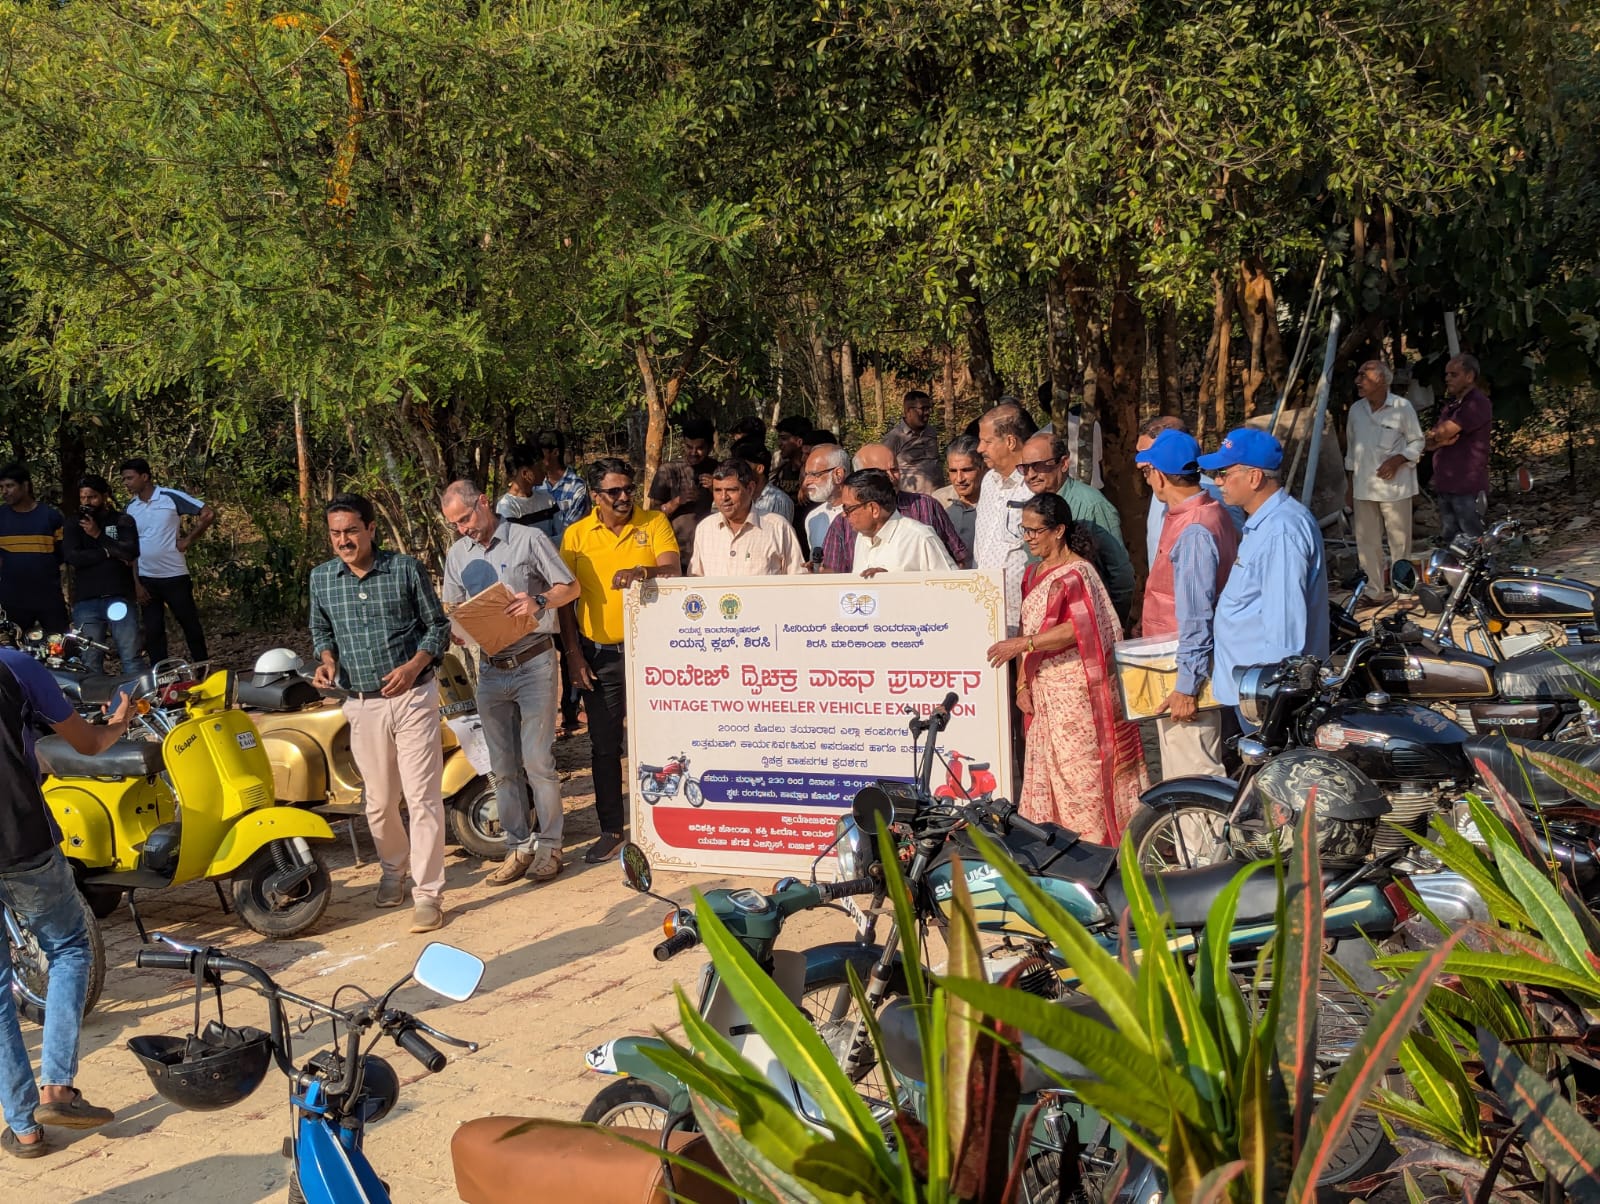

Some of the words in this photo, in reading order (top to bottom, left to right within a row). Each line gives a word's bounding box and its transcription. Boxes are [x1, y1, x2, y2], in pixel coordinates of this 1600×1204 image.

[744, 636, 771, 648] ಶಿರಸಿ
[645, 664, 730, 687] ವಿಂಟೇಜ್
[741, 664, 798, 695] ದ್ವಿಚಕ್ರ
[809, 669, 875, 694] ವಾಹನ
[887, 670, 982, 695] ಪ್ರದರ್ಶನ
[649, 699, 708, 712] VINTAGE
[711, 700, 744, 712] TWO
[747, 700, 816, 713] WHEELER
[819, 701, 882, 714] VEHICLE
[173, 733, 198, 756] Vespa
[934, 864, 991, 897] SUUKI
